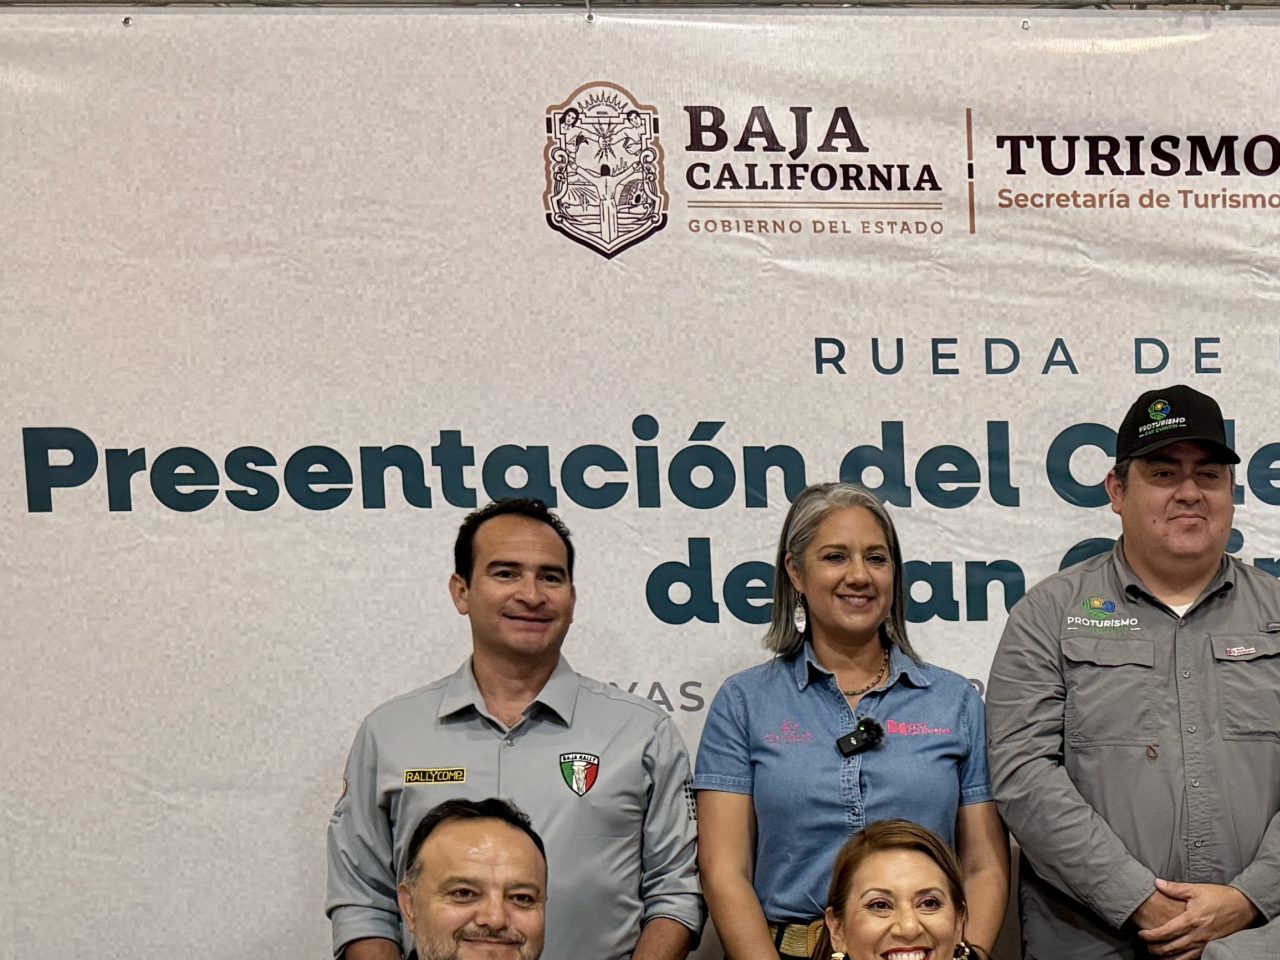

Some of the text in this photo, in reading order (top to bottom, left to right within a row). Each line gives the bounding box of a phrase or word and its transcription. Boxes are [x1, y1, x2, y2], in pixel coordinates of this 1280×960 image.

[683, 105, 868, 160] BAJA
[686, 162, 943, 192] CALIFORNIA
[997, 186, 1131, 210] Secretaría
[1138, 188, 1171, 209] de
[688, 219, 944, 236] GOBIERNO DEL ESTADO
[814, 337, 1079, 375] RUEDA
[1134, 337, 1222, 374] DE
[1138, 417, 1186, 433] PROTURISMO
[22, 414, 806, 512] Presentación
[839, 421, 1020, 508] del
[645, 537, 779, 626] de
[902, 559, 1025, 623] an
[1067, 616, 1139, 628] PROTURISMO
